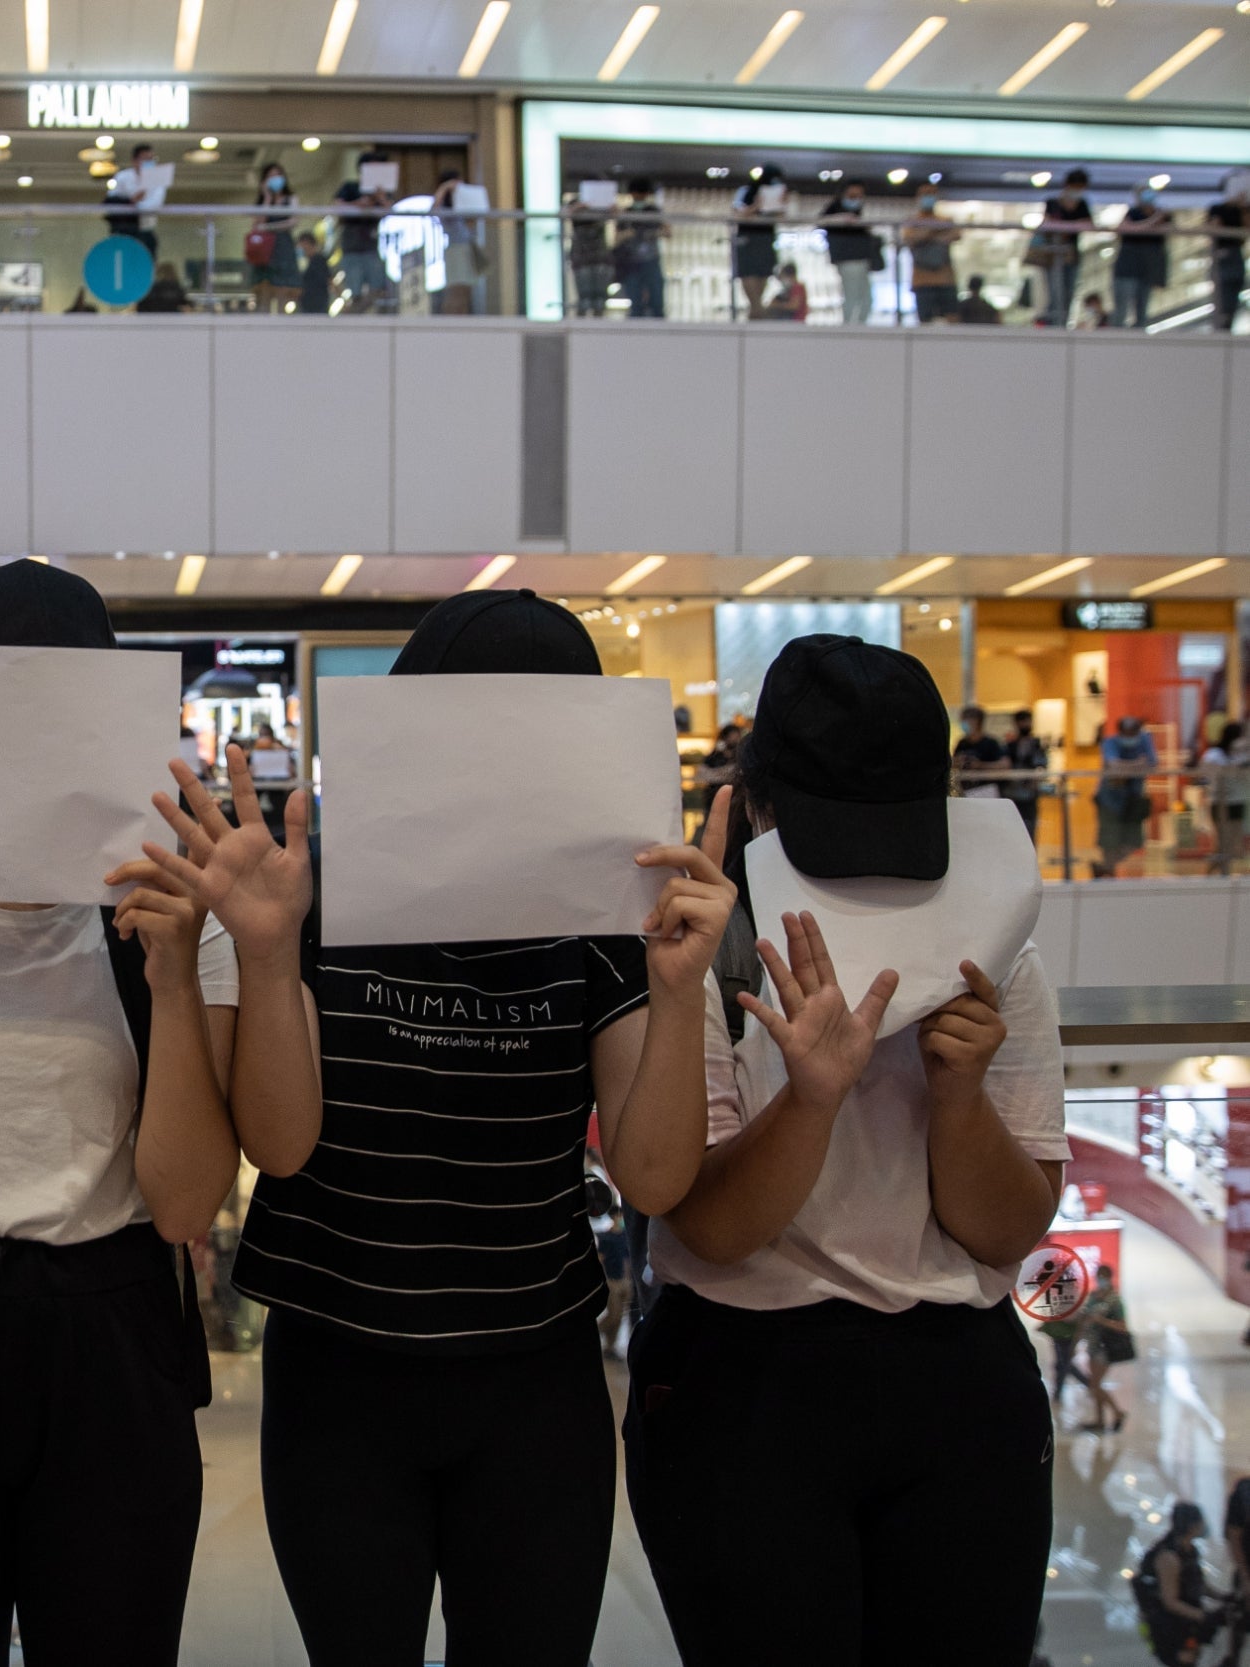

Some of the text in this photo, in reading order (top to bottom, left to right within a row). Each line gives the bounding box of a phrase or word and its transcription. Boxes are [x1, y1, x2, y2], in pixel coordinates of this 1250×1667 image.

[28, 83, 189, 128] PALLADIUM
[400, 1030, 412, 1039] an
[483, 1035, 497, 1053] of
